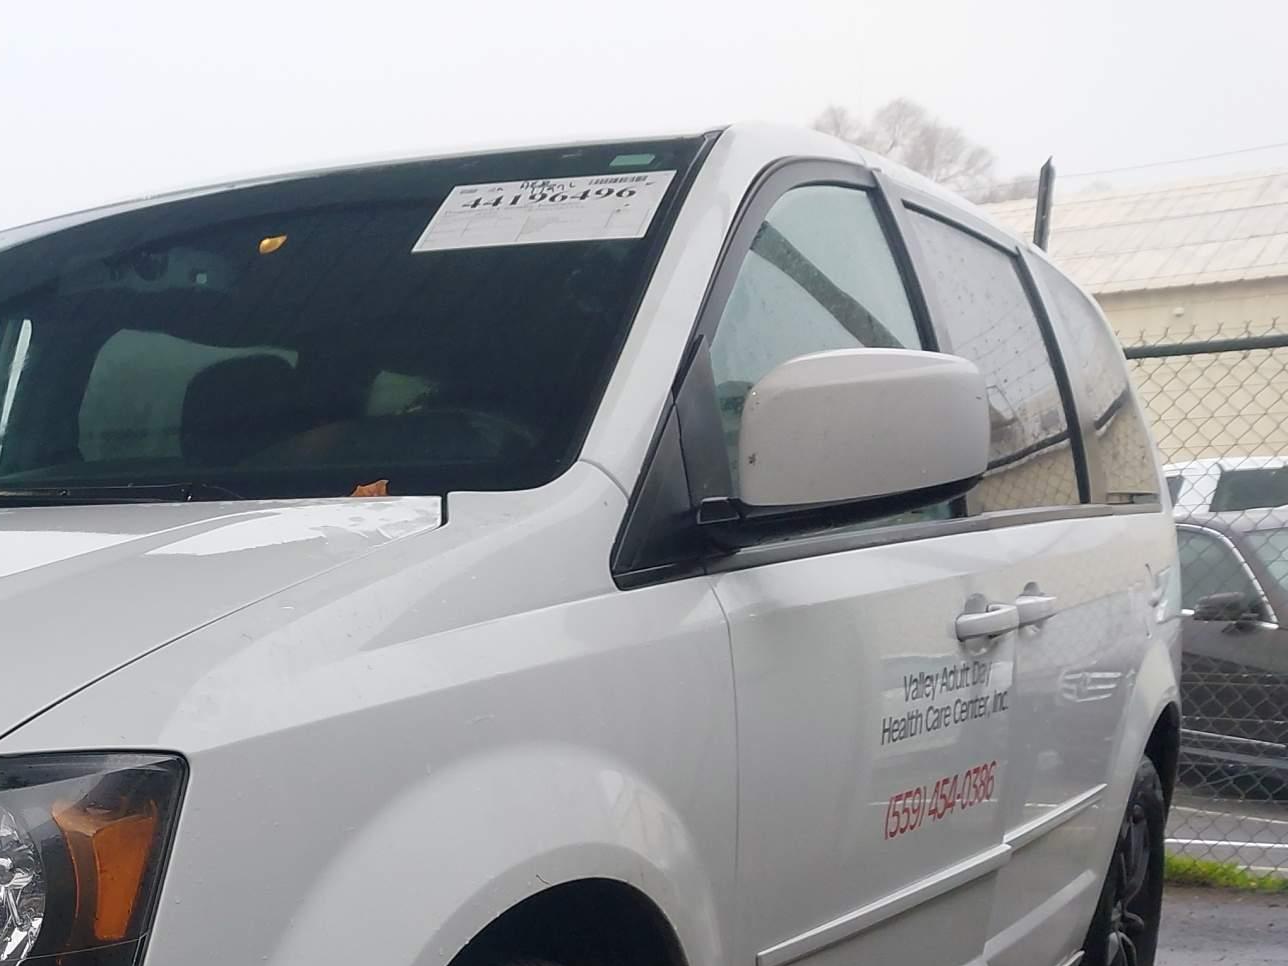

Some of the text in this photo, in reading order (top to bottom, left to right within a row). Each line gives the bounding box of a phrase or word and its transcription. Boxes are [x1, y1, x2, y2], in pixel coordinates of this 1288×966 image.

[462, 186, 637, 210] 44196496
[904, 672, 938, 702] Valley
[939, 663, 971, 693] Adult
[881, 709, 923, 745] Health
[925, 704, 952, 732] Care
[884, 760, 998, 840] (559) 454-0386
